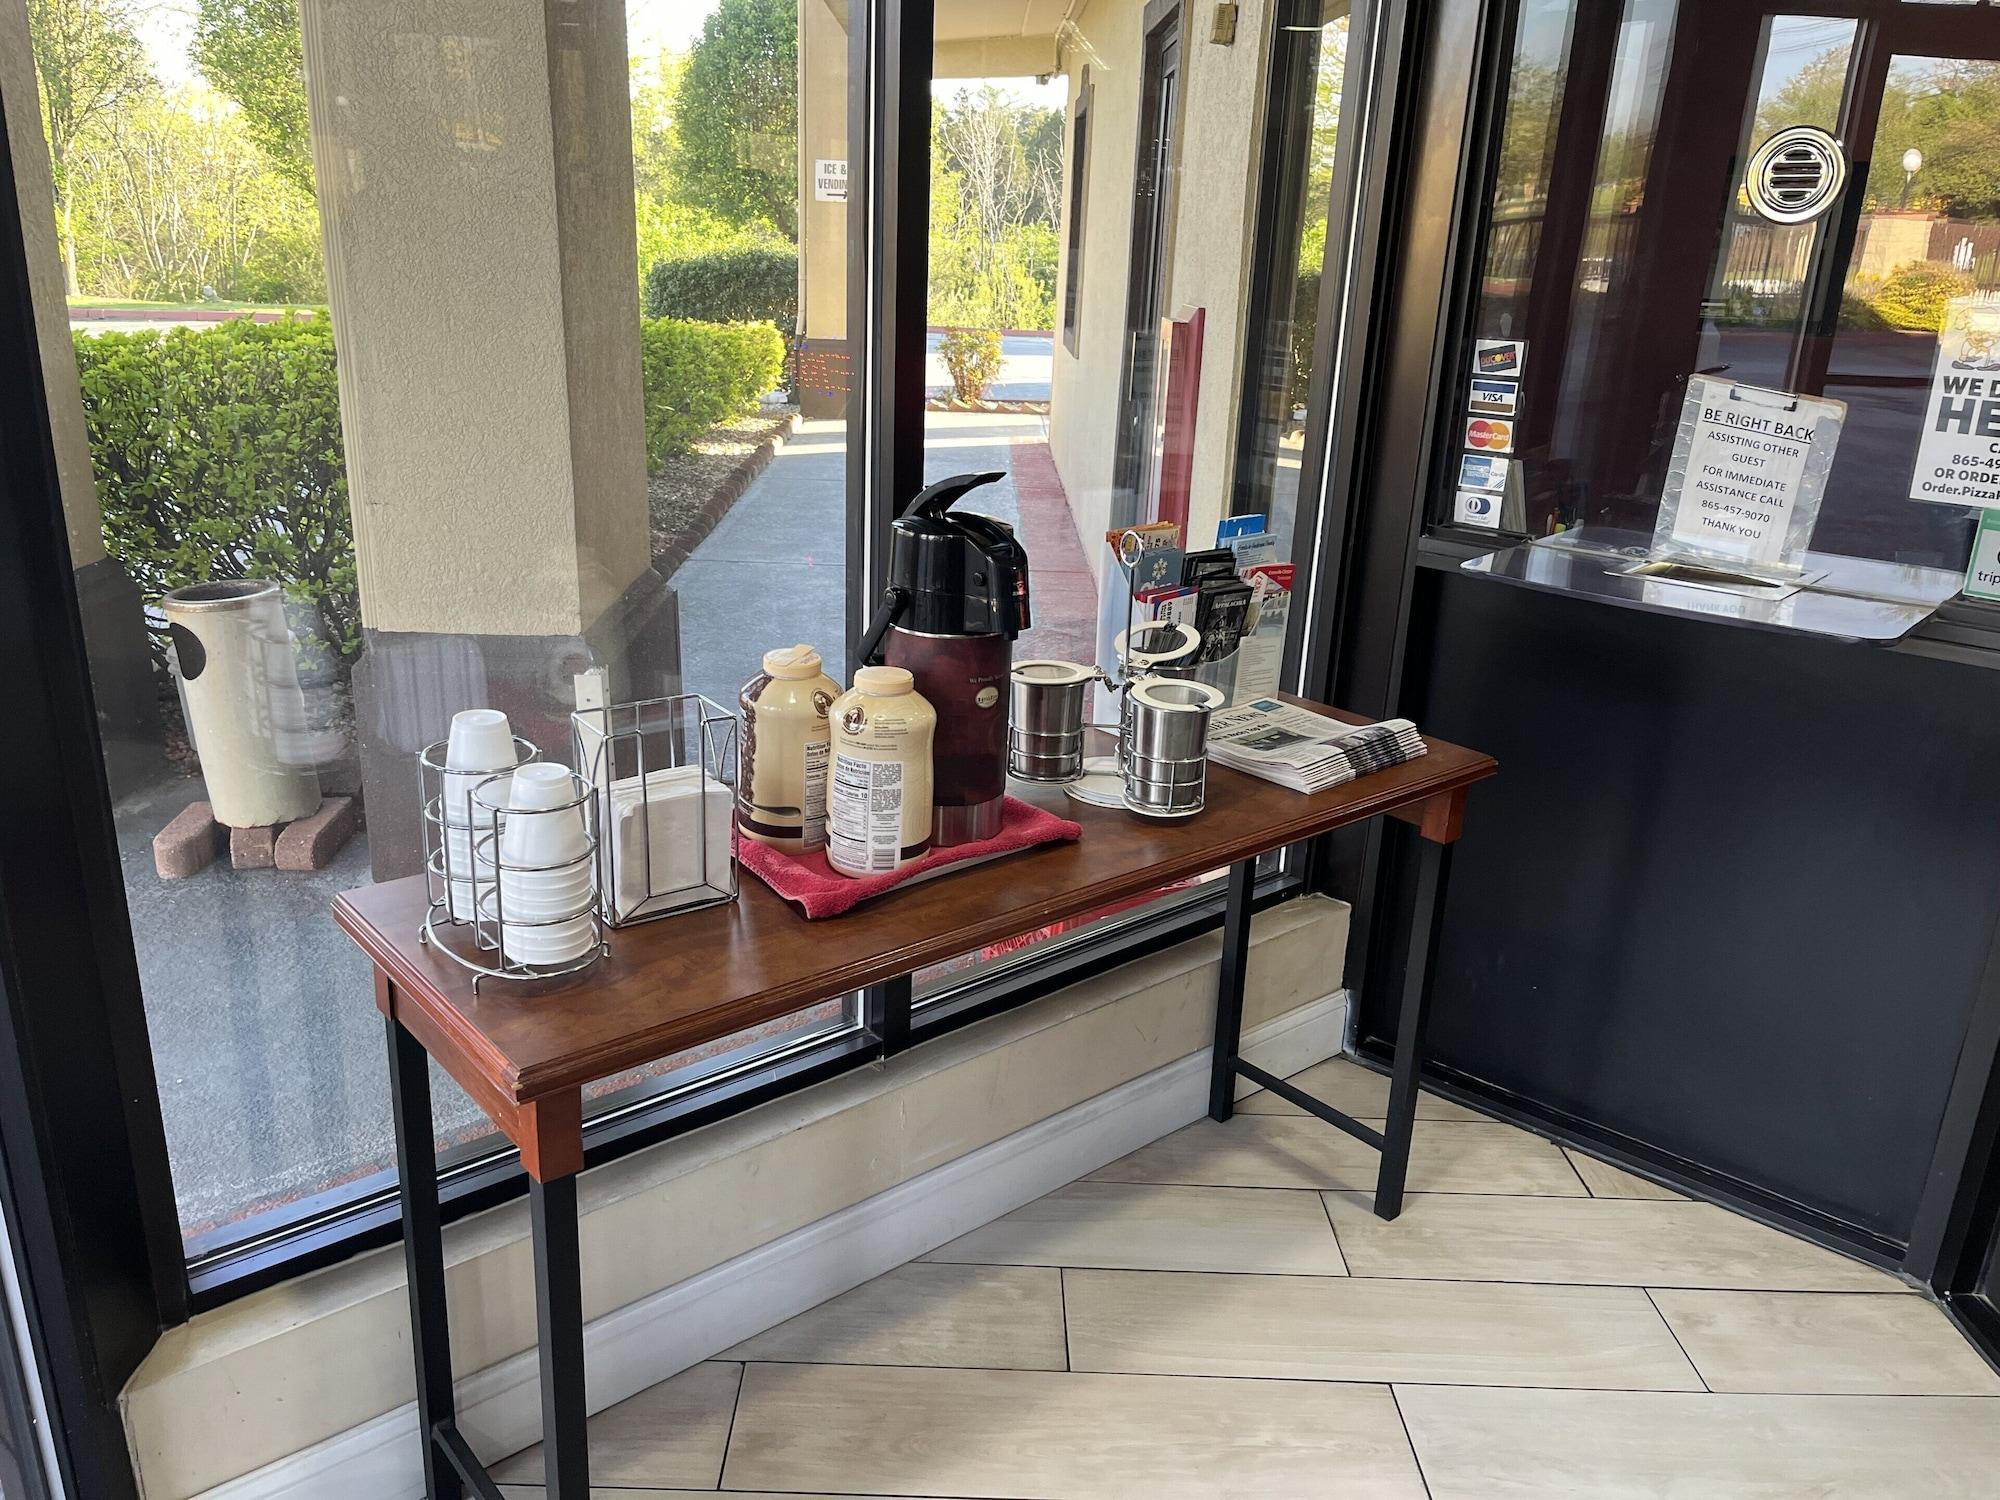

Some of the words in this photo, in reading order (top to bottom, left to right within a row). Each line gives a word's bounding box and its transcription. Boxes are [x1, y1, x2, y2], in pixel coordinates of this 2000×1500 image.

[824, 163, 837, 175] ICE
[840, 164, 847, 175] &
[1943, 375, 1984, 396] WE
[1482, 392, 1503, 403] VISA
[1703, 408, 1723, 422] BE
[1725, 412, 1772, 432] RIGHT
[1774, 422, 1815, 441] BACK
[1935, 396, 2000, 437] HE
[1468, 429, 1510, 441] MasterCard
[1707, 431, 1761, 450] ASSISTING
[1763, 443, 1800, 458] OTHER
[1731, 453, 1767, 468] GUEST
[1702, 465, 1723, 477] FOR
[1725, 470, 1788, 492] IMMEDIATE
[1934, 467, 1955, 479] OR
[1696, 480, 1758, 502] ASSISTANCE
[1759, 495, 1784, 508] CALL
[1701, 499, 1770, 523] 865-457-9070
[1702, 517, 1737, 533] THANK
[1739, 526, 1761, 539] YOU
[1978, 570, 2000, 586] trip
